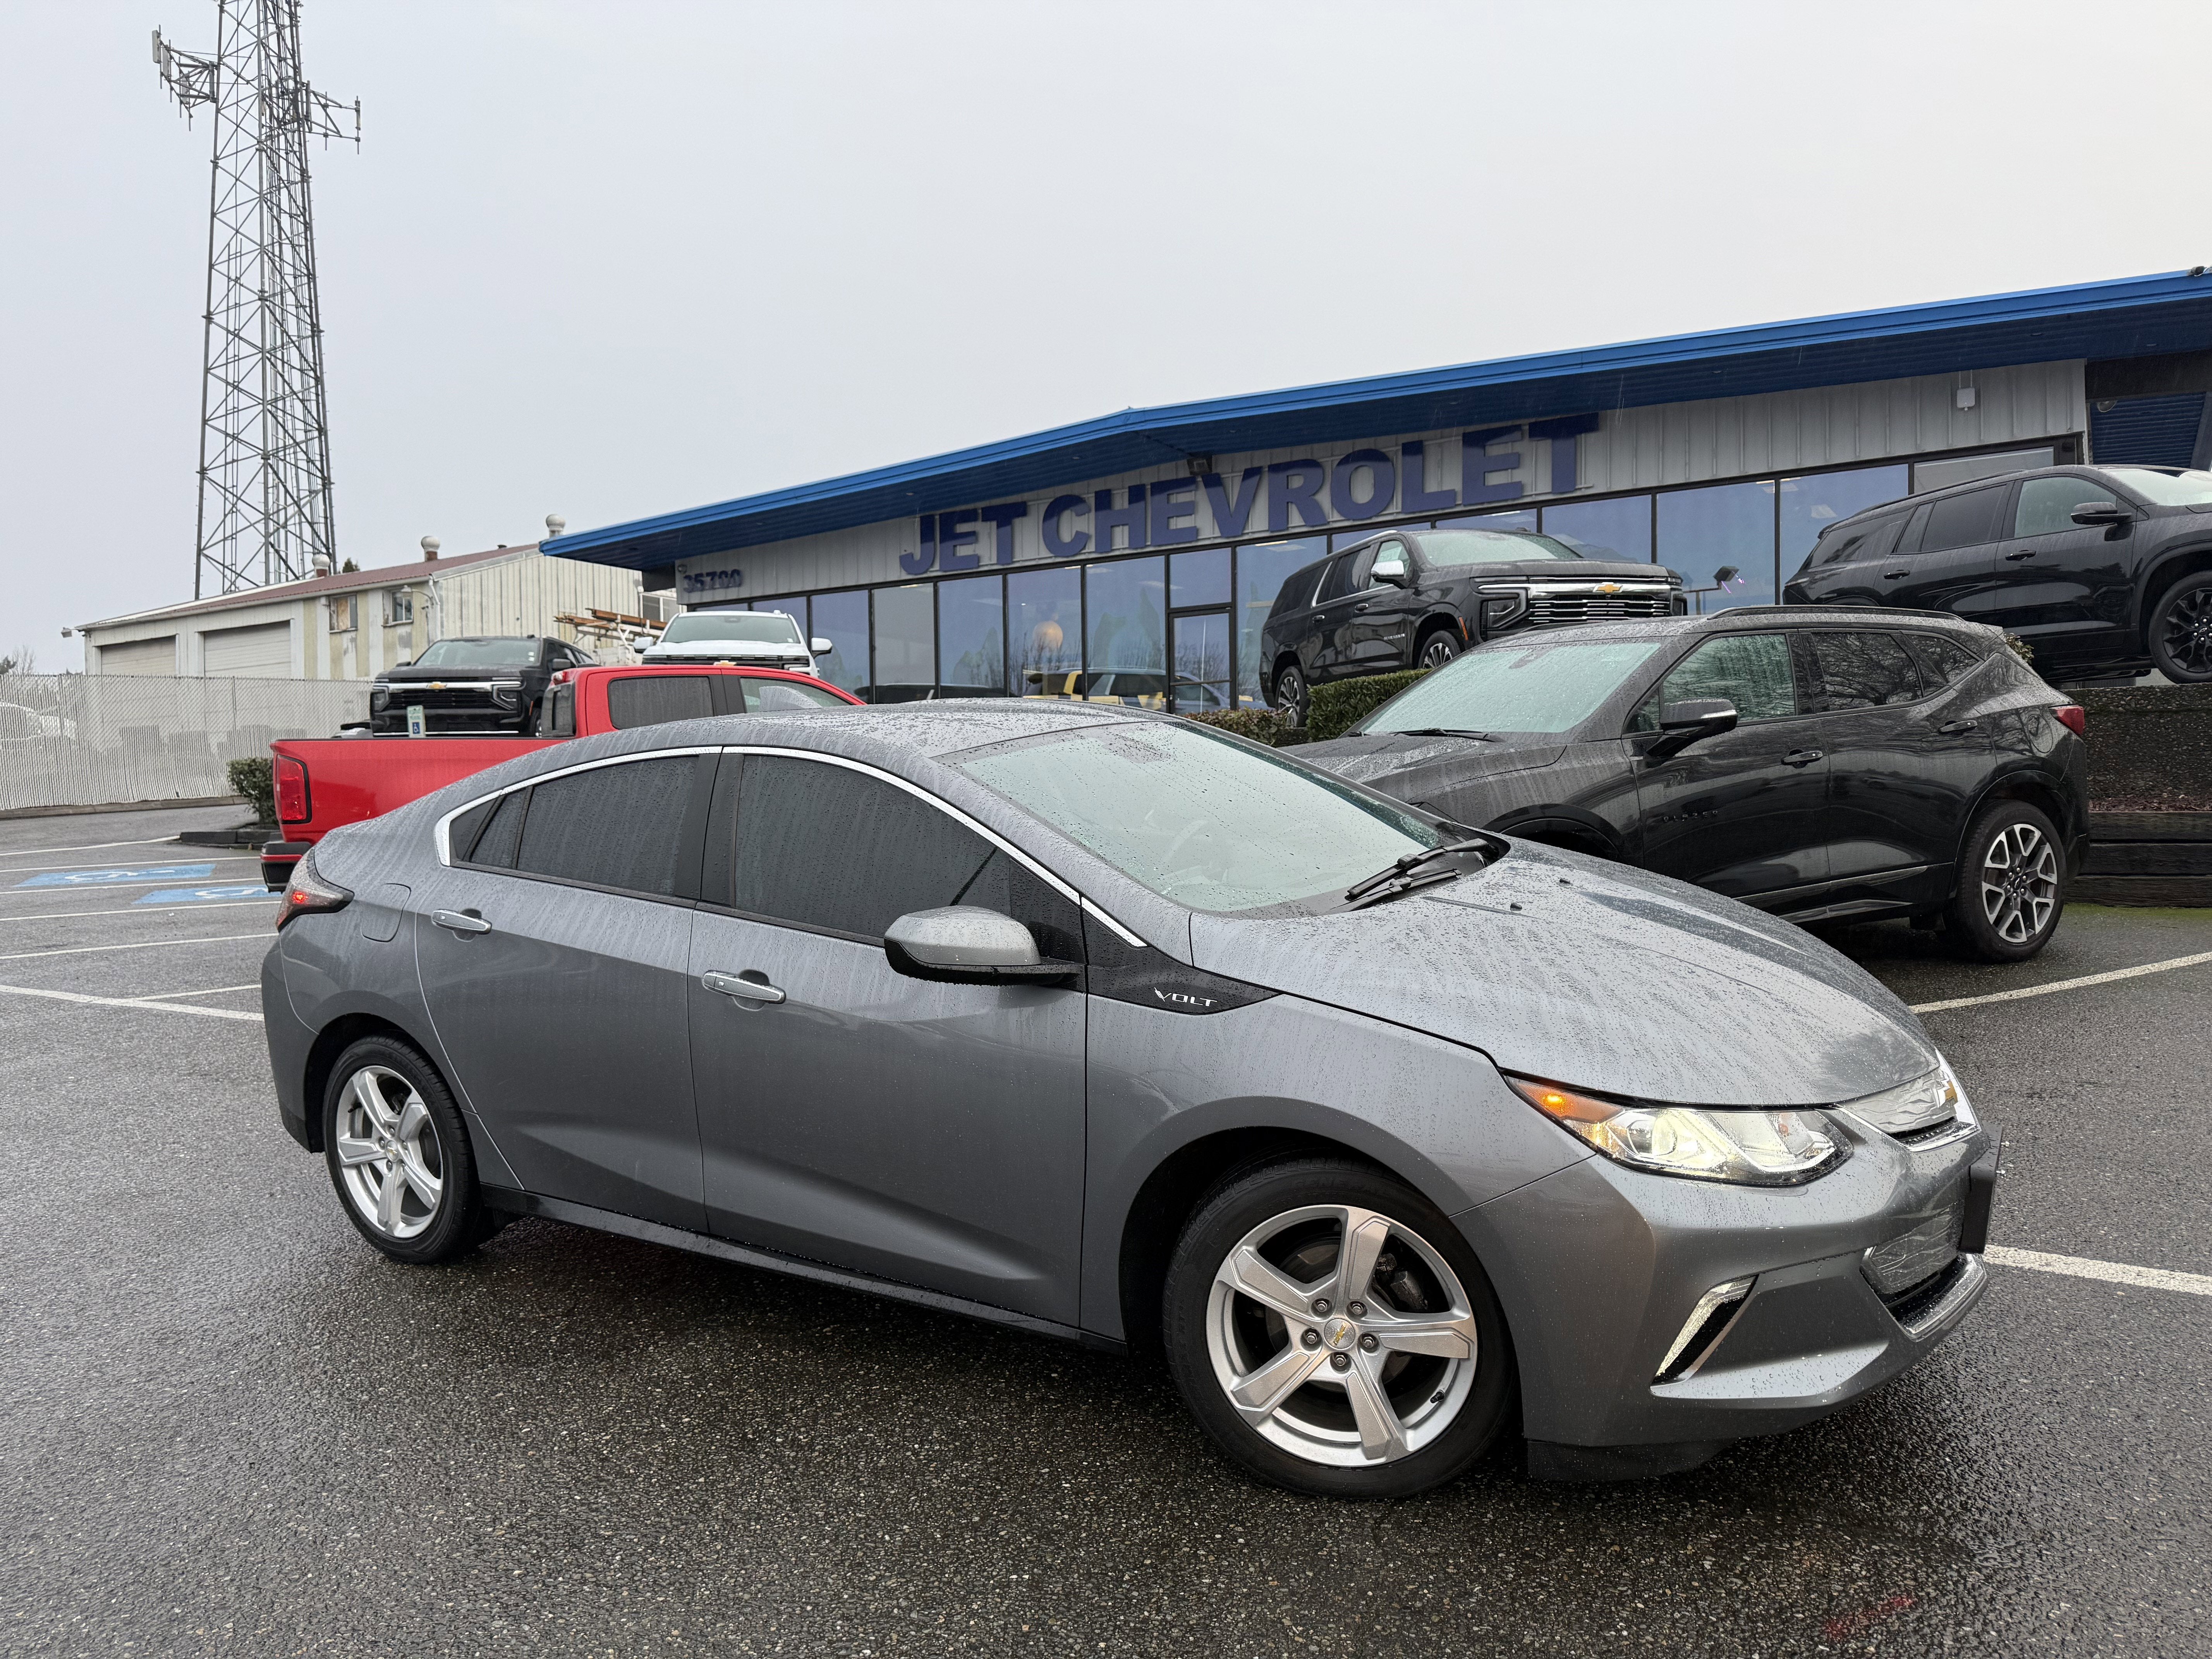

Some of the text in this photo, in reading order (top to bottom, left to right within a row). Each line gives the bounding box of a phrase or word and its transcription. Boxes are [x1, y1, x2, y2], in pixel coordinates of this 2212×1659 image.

[899, 412, 1599, 575] JET CHEVROLET
[1154, 987, 1218, 1007] VOLT
